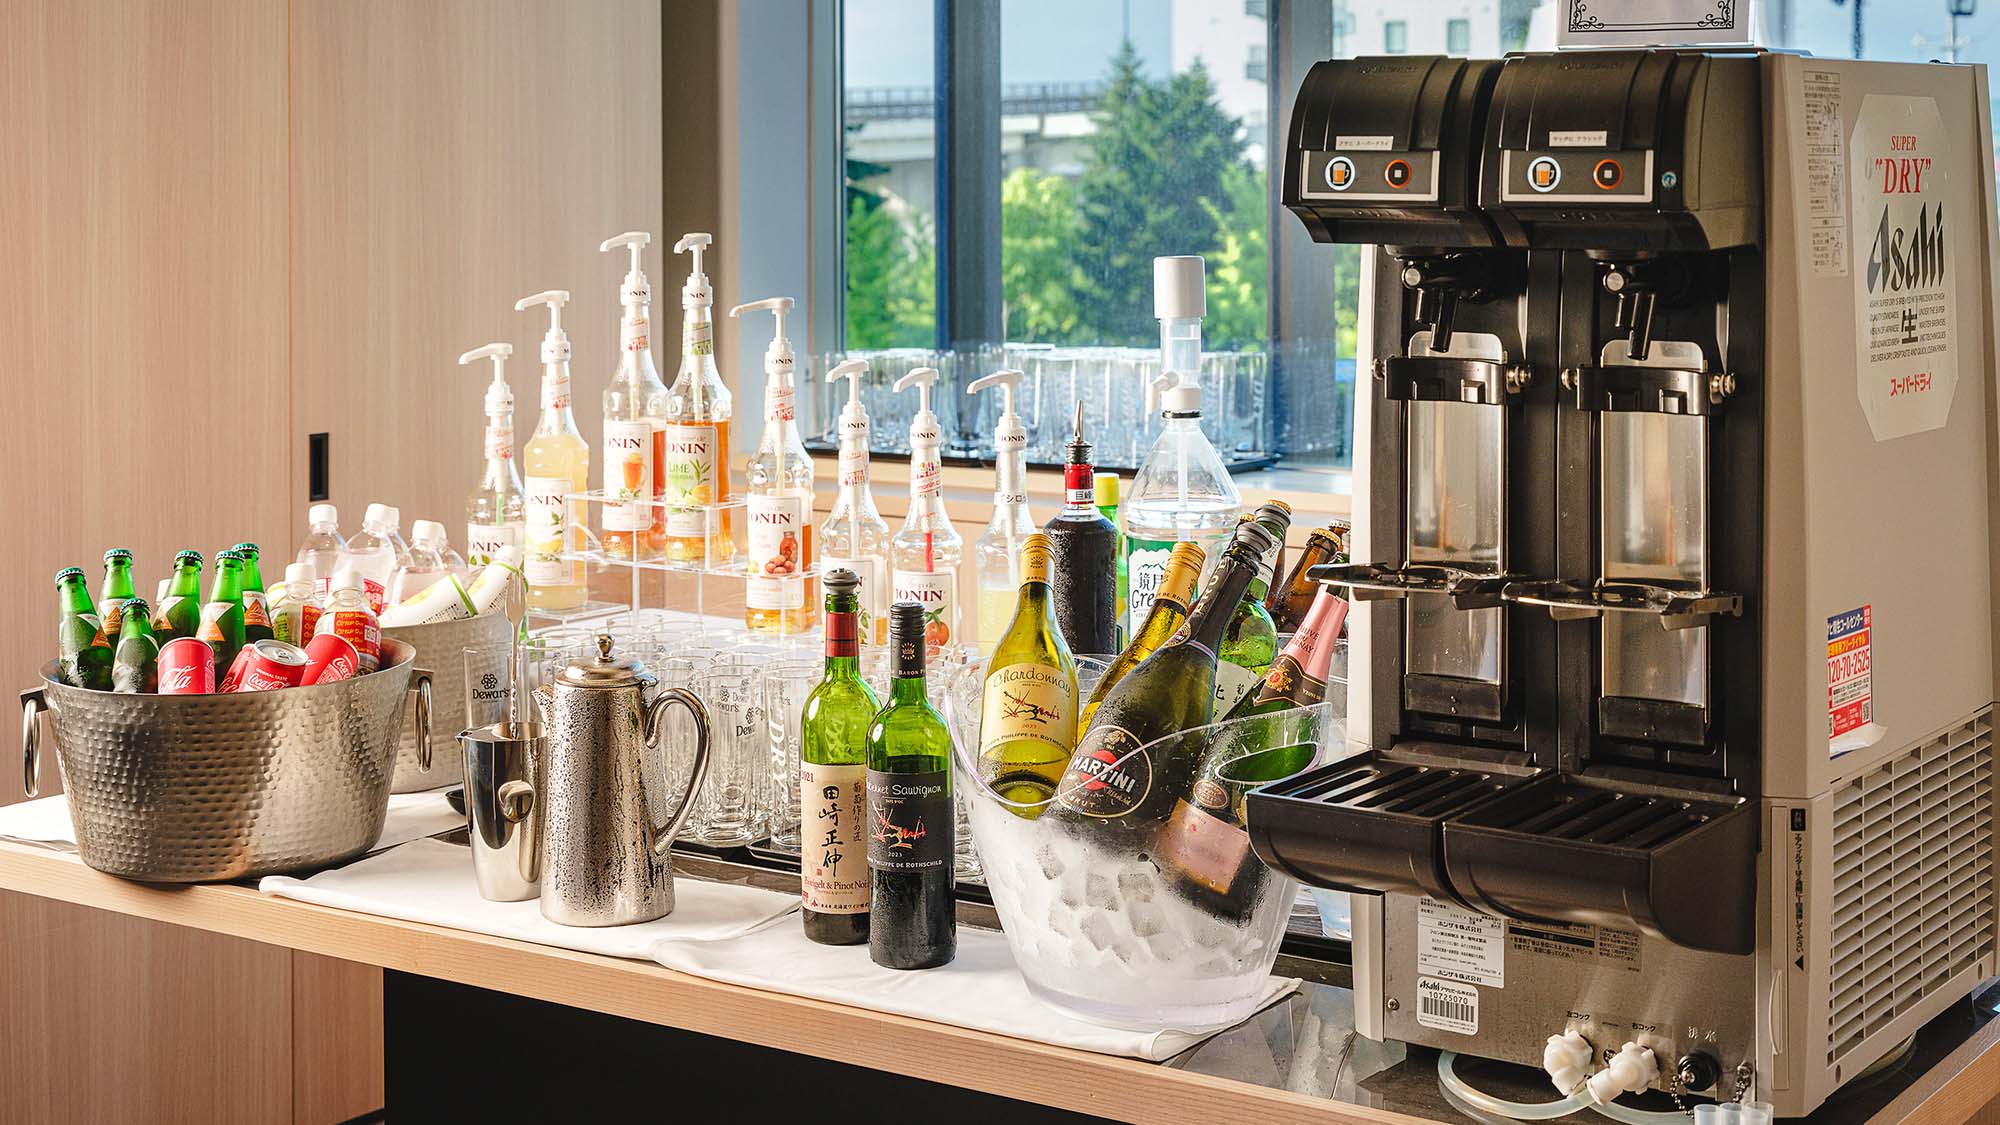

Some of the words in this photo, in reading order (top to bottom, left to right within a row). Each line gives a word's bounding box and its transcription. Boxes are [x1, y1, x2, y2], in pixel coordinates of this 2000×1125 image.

[1891, 135, 1917, 151] SUPER
[1867, 201, 1944, 294] Asahi
[1901, 308, 1918, 344] 生
[1890, 372, 1931, 397] スーパードライ
[1075, 490, 1092, 500] 巨峰
[1132, 589, 1155, 609] Gre
[993, 667, 1071, 697] Chardonnay
[472, 687, 511, 700] Dewar's
[1001, 731, 1027, 740] PHILIPPE
[1070, 756, 1136, 793] MARTINI
[892, 784, 942, 799] Sauvignon
[818, 785, 845, 878] 田崎正伸
[905, 859, 943, 869] ROTHSCHILD
[833, 881, 854, 890] Pinot
[1420, 980, 1440, 991] Asahi
[1429, 991, 1468, 1005] 10725070
[1566, 1010, 1591, 1022] 左コック
[1631, 1022, 1656, 1033] 右コック
